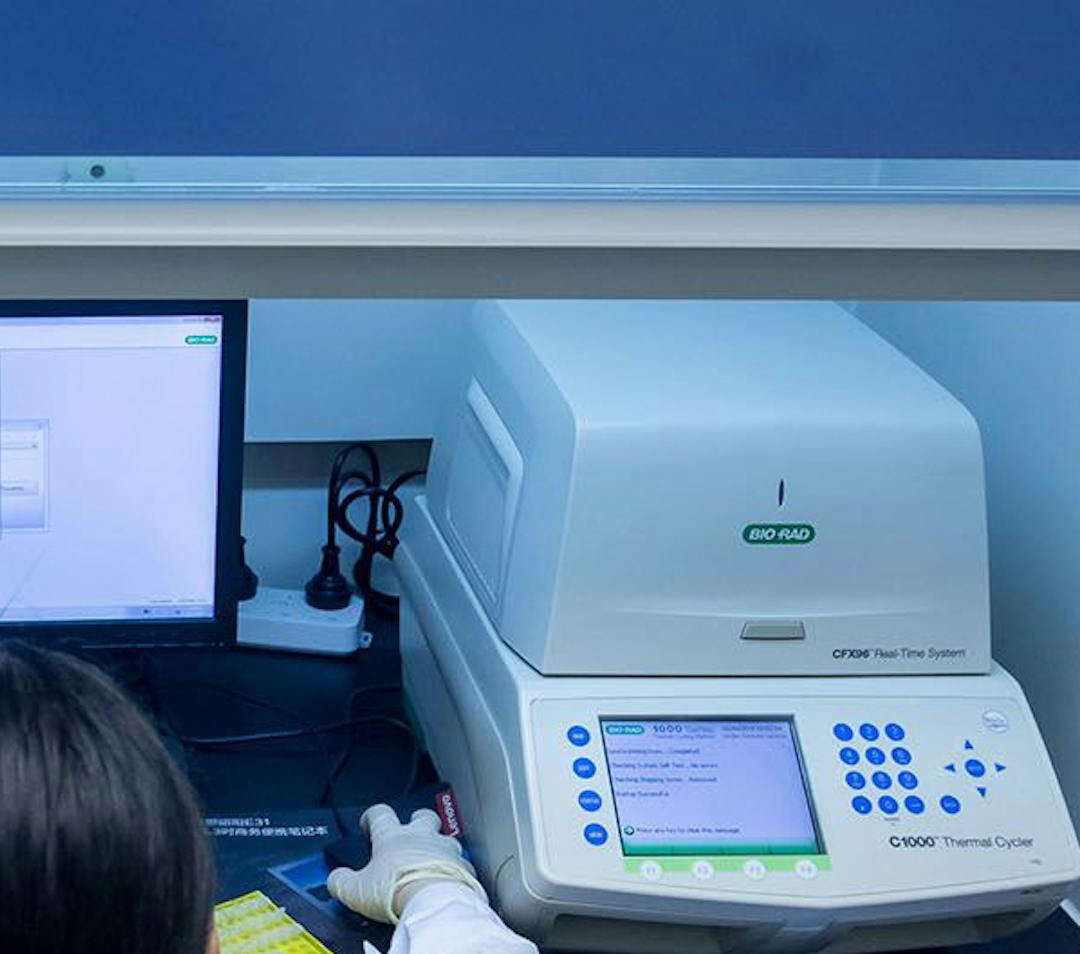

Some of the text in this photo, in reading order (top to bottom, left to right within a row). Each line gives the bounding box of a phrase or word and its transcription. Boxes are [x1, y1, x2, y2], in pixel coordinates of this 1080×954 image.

[874, 647, 925, 659] Real-Time
[927, 647, 967, 661] System
[942, 835, 992, 848] Thermal
[994, 835, 1033, 850] Cycler
